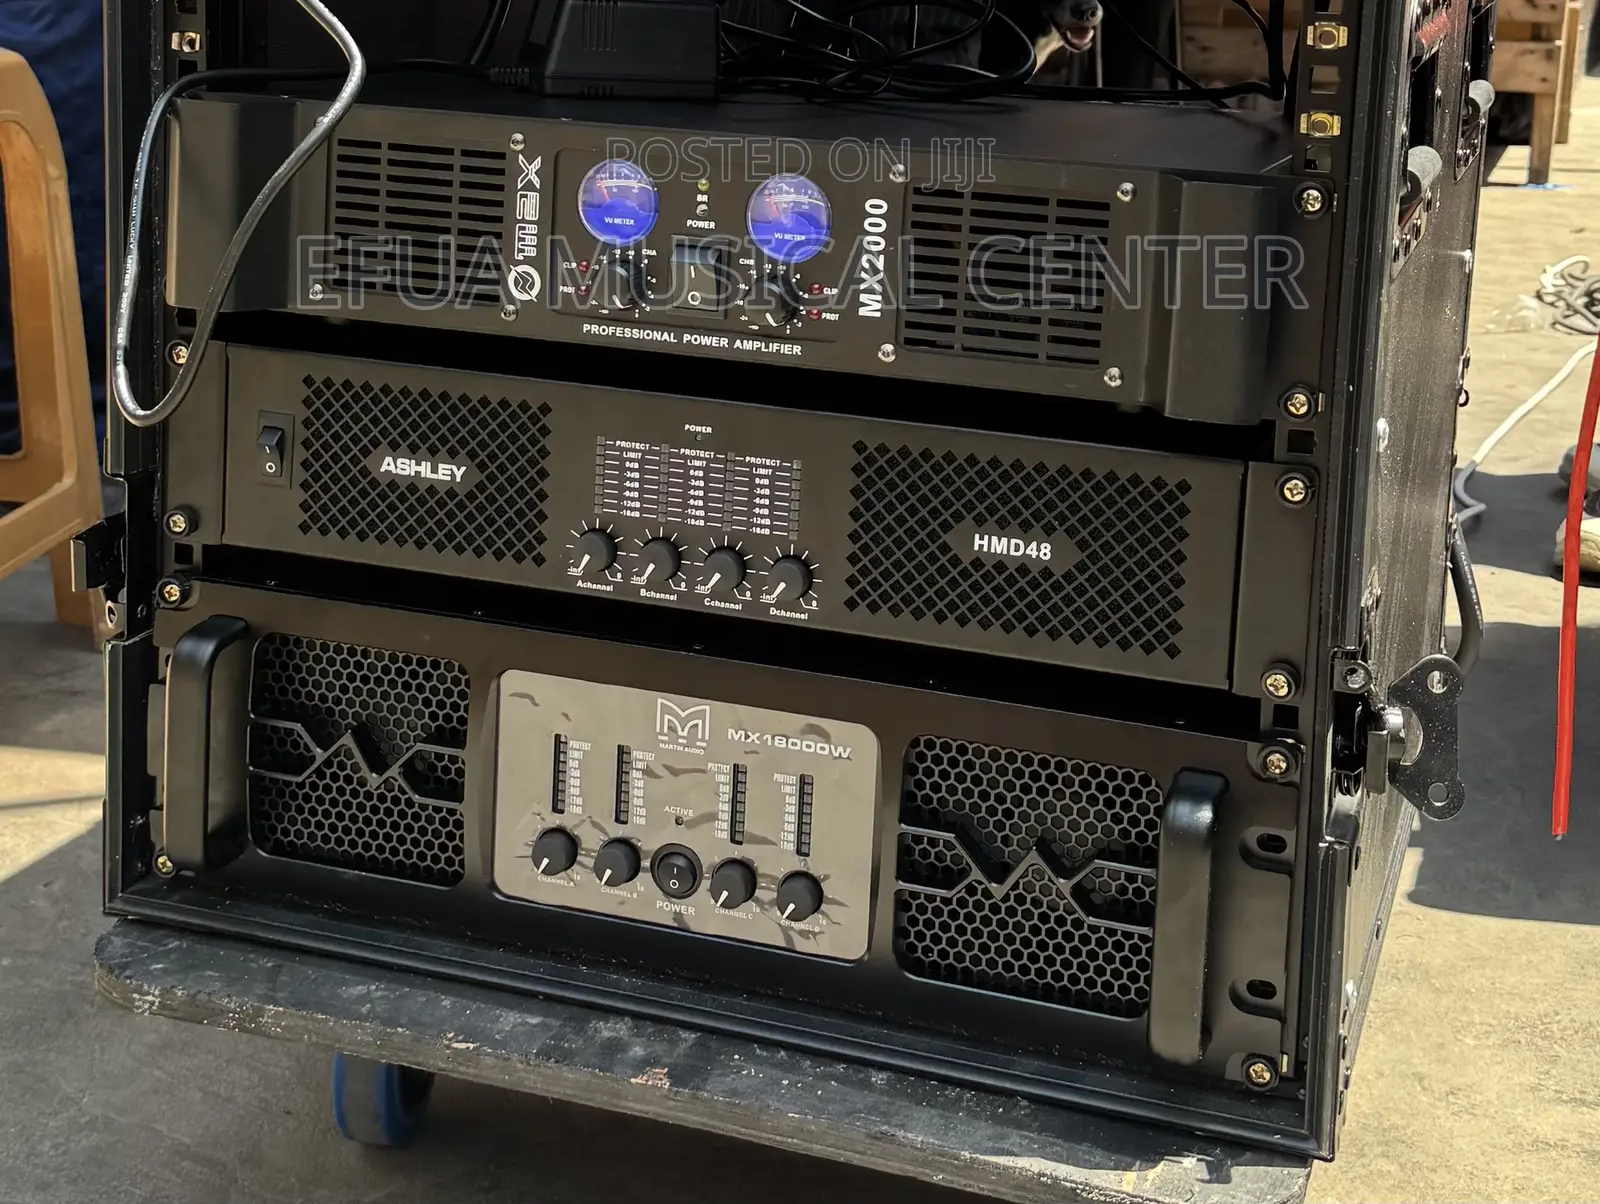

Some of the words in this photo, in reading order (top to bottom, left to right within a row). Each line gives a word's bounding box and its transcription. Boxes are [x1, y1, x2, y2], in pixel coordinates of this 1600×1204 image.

[687, 219, 716, 230] POWER
[784, 233, 806, 241] METER
[859, 198, 889, 318] MX2000
[560, 286, 576, 294] PROT
[823, 287, 838, 295] CLIP
[822, 313, 840, 321] PROT
[583, 323, 678, 344] PROFESSIONAL
[683, 334, 729, 348] POWER
[733, 338, 802, 356] AMPLIFIER
[685, 424, 713, 434] POWER
[616, 440, 650, 450] PROTECT
[623, 451, 642, 459] LIMIT
[680, 448, 715, 458] PROTECT
[687, 459, 707, 467] LIMIT
[745, 456, 781, 467] PROTECT
[380, 456, 467, 483] ASHLEY
[753, 467, 773, 476] LIMIT
[621, 500, 641, 508] -12dB
[685, 508, 705, 517] -12dB
[750, 517, 771, 526] -12dB
[973, 533, 1052, 561] HMD48
[576, 580, 614, 592] Achannel
[640, 588, 678, 601] Bchannel
[704, 598, 742, 610] Cchannel
[770, 607, 808, 620] Dchannel
[570, 740, 592, 751] PROTECT
[659, 742, 684, 753] MARTIN
[684, 746, 705, 755] AUDIO
[633, 750, 655, 761] PROTECT
[774, 773, 797, 785] PROTECT
[664, 805, 694, 817] ACTIVE
[538, 875, 568, 886] CHANNEL
[601, 887, 633, 898] CHANNEL
[656, 900, 696, 916] POWER
[715, 908, 748, 919] CHANNEL
[781, 920, 814, 931] CHANNEL
